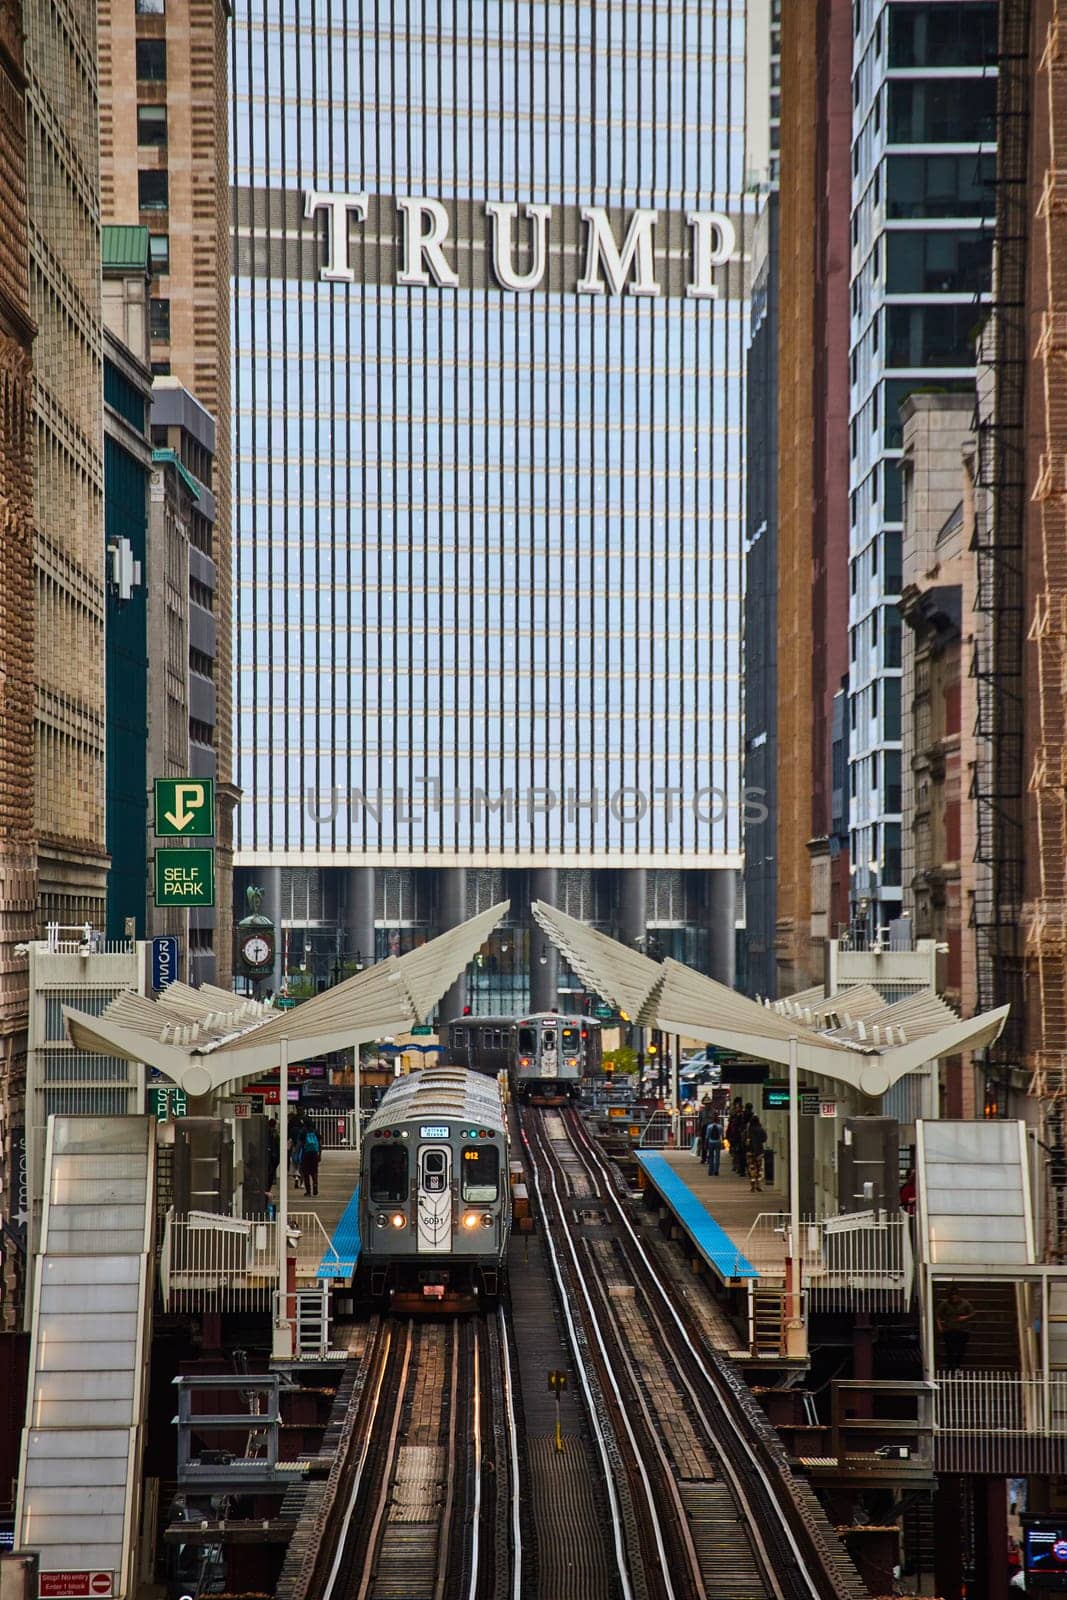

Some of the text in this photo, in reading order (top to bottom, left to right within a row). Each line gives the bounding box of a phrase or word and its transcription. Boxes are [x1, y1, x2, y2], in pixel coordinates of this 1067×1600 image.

[303, 190, 738, 299] TRUMP
[163, 868, 200, 881] SELF
[163, 882, 204, 896] PARK
[158, 940, 171, 988] ROSS
[157, 1088, 186, 1101] SEL
[157, 1103, 186, 1116] PR
[235, 1104, 249, 1114] EXIT
[822, 1104, 836, 1114] EXIT
[423, 1217, 444, 1225] 5091
[72, 1574, 88, 1582] entry
